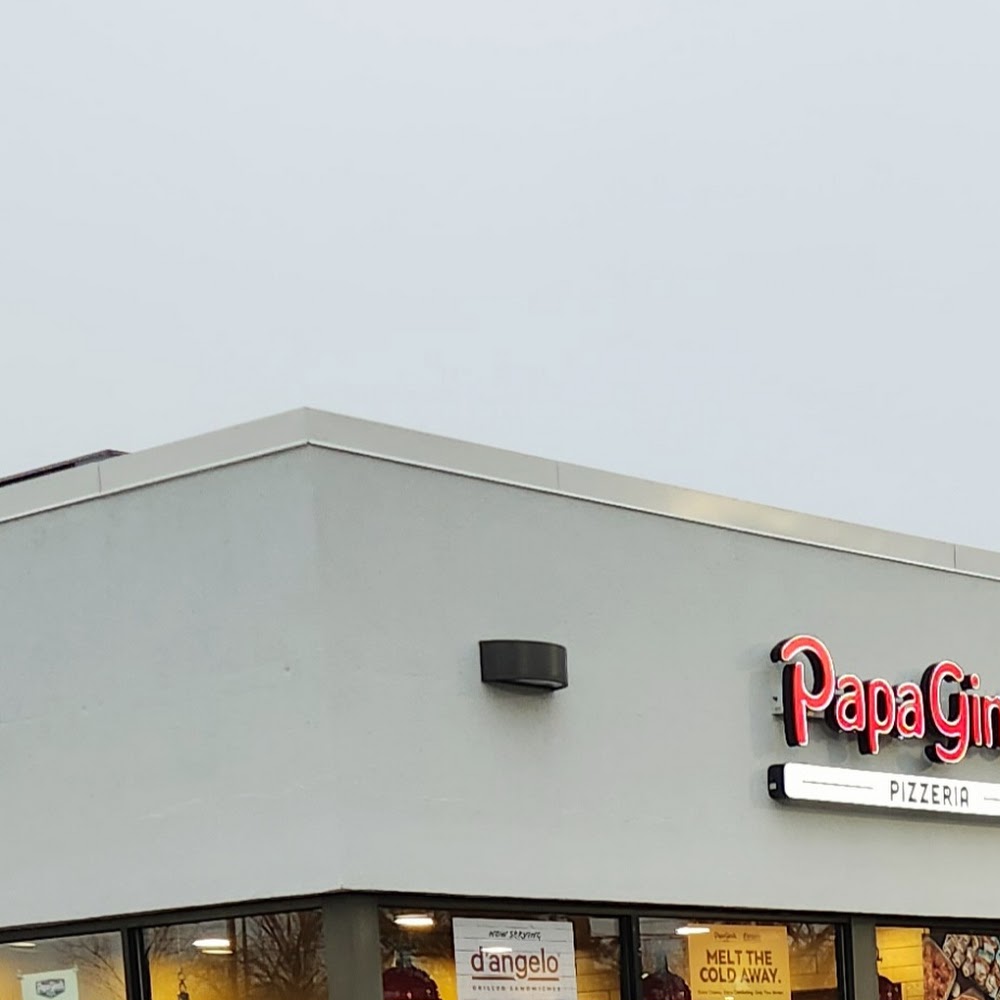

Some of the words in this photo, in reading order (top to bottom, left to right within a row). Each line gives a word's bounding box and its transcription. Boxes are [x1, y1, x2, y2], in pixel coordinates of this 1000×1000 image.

[889, 779, 970, 807] PIZZERIA
[488, 930, 508, 938] NOW
[509, 930, 542, 941] SERVING
[470, 946, 559, 979] d'angelo
[705, 949, 742, 966] MELT
[745, 950, 773, 966] THE
[699, 966, 737, 983] COLD
[740, 967, 782, 984] AWAY.
